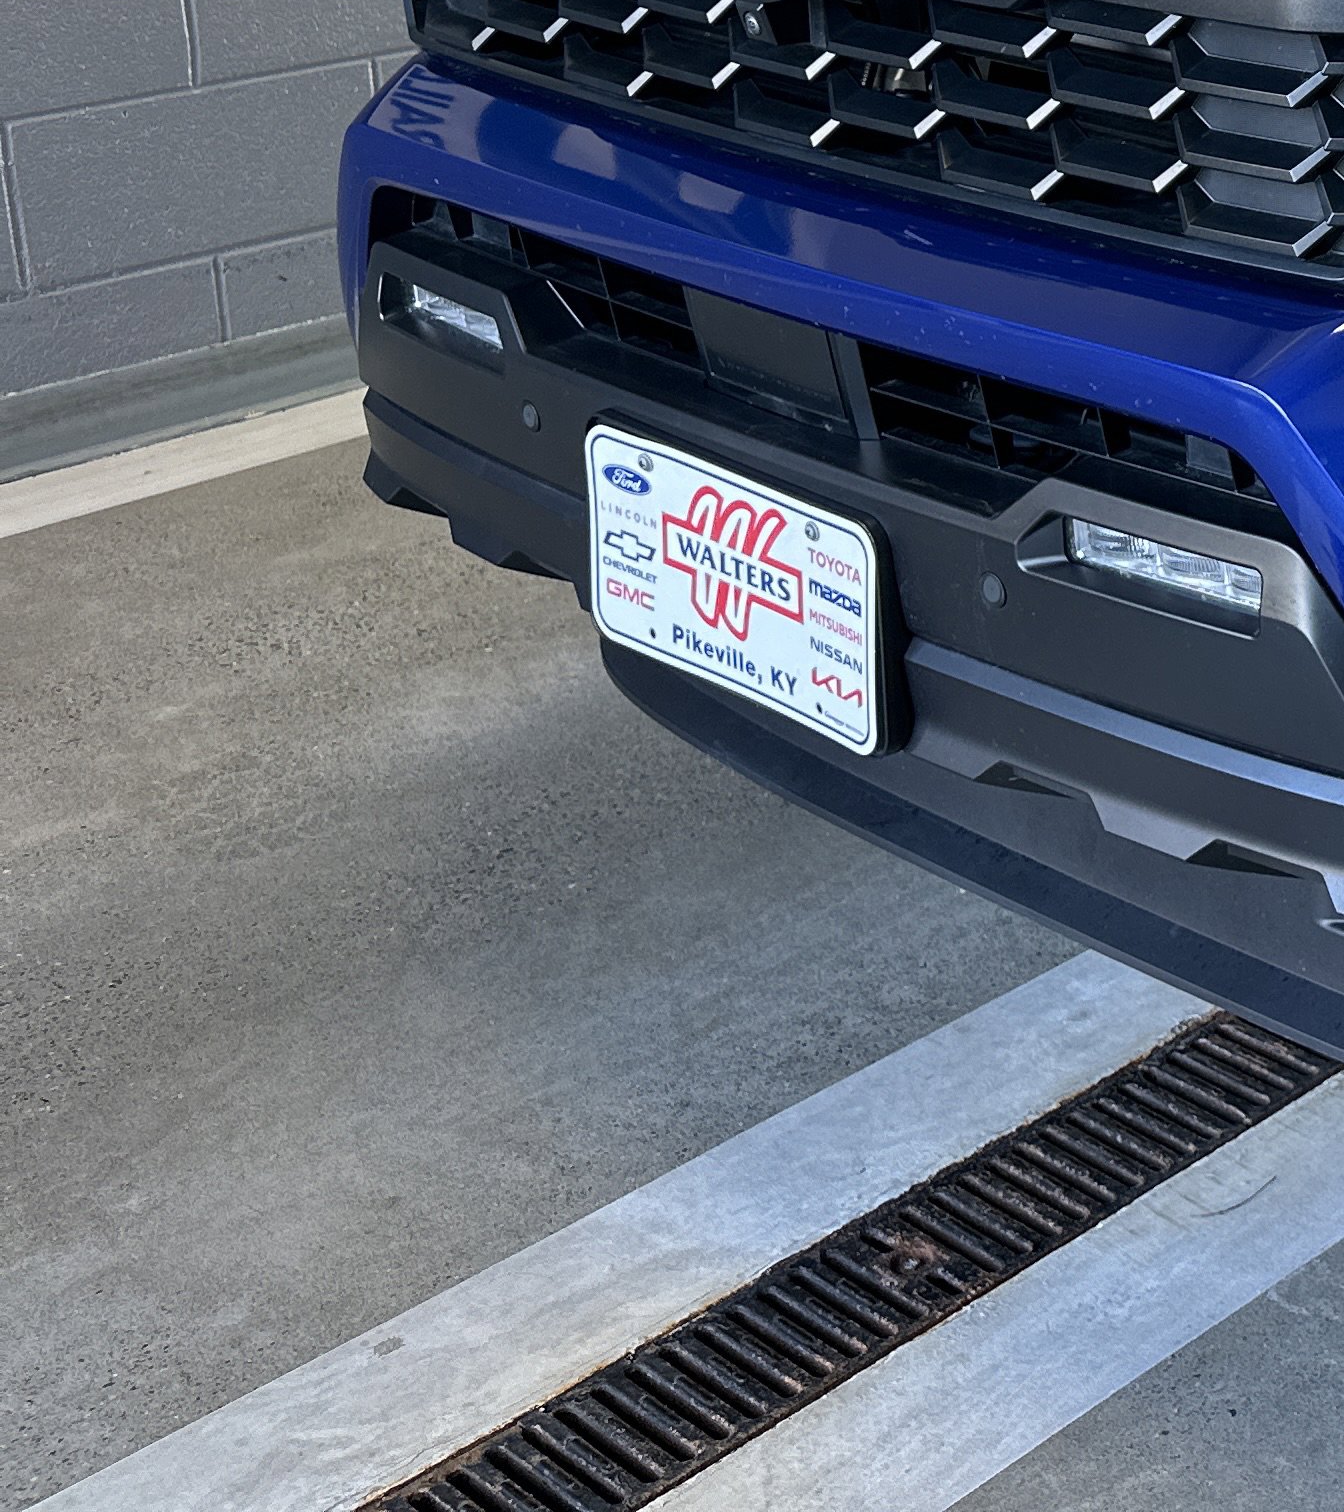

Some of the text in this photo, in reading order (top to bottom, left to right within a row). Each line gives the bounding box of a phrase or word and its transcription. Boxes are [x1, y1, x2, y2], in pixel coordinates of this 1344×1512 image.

[612, 469, 642, 492] Ford
[601, 500, 657, 529] LINCOLN
[603, 555, 657, 584] CHEVROLET
[676, 532, 791, 602] WALTERS
[807, 547, 862, 586] TOYOTA
[606, 577, 655, 611] GMC
[809, 608, 863, 646] MITSUBISHI
[672, 623, 798, 696] Pikeville, KY
[810, 636, 863, 675] NISSAN
